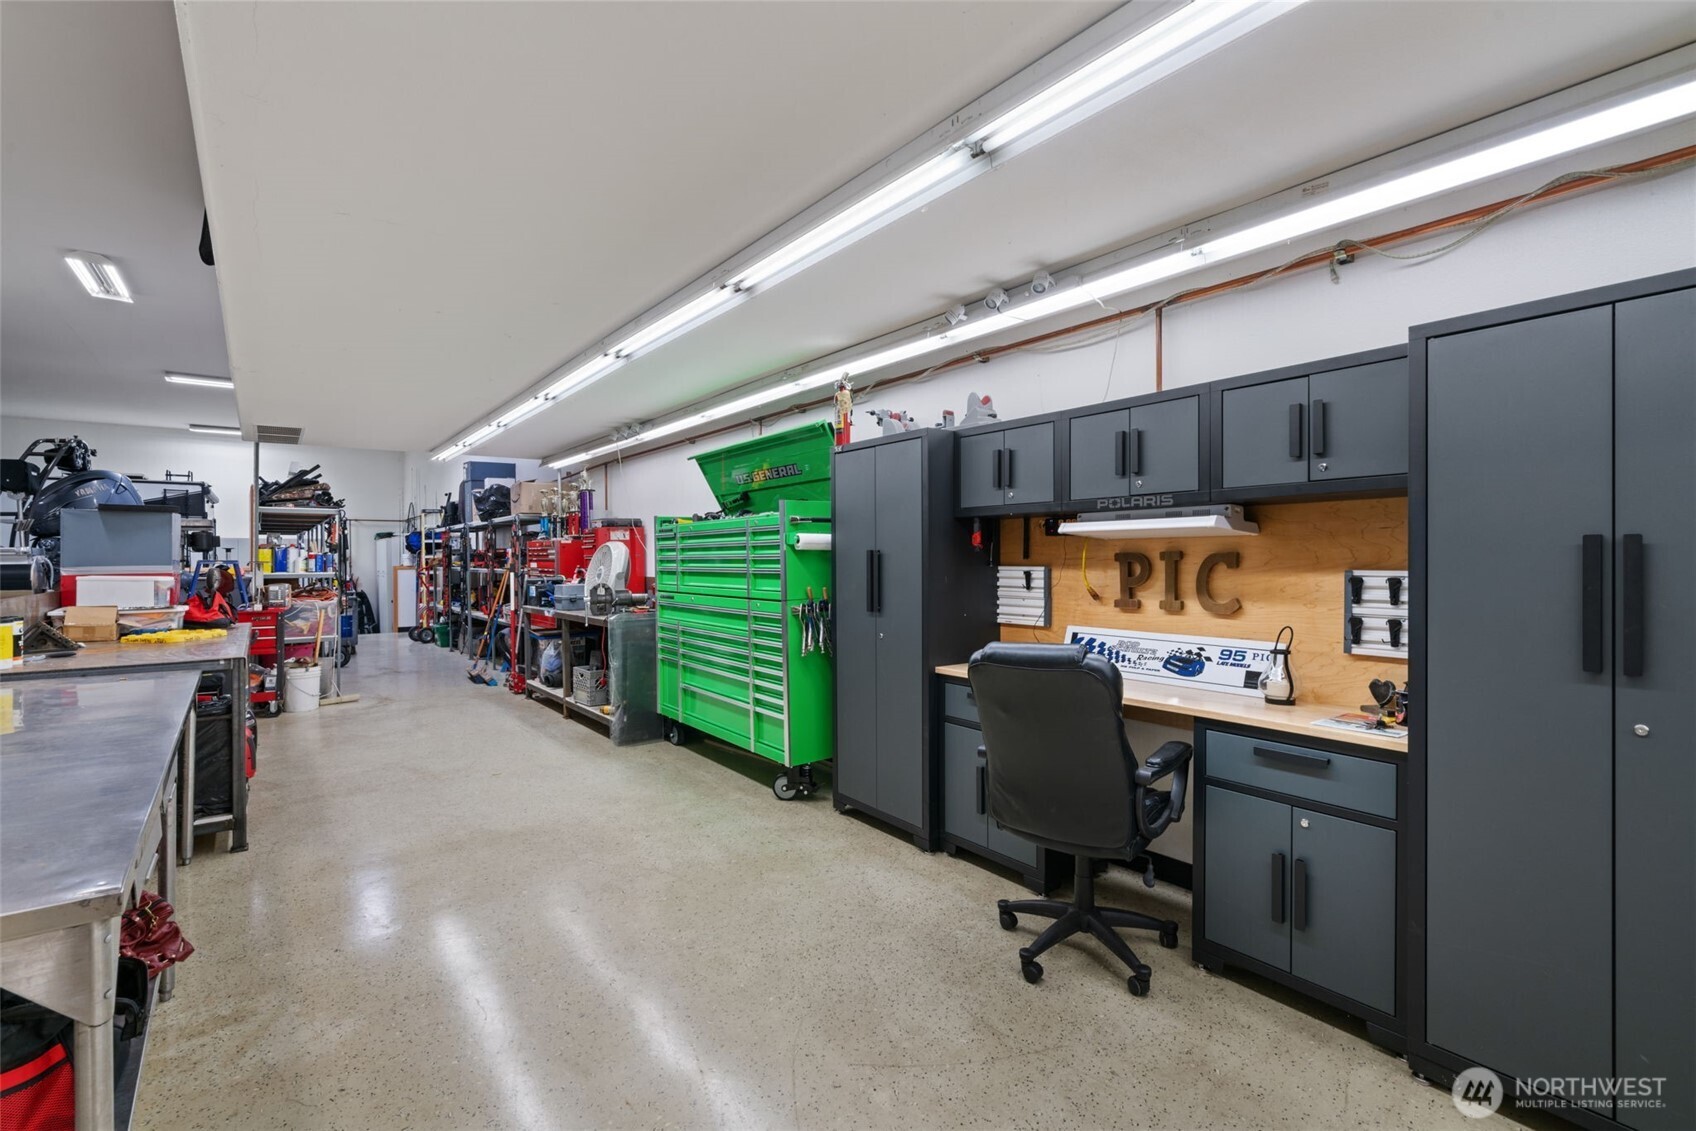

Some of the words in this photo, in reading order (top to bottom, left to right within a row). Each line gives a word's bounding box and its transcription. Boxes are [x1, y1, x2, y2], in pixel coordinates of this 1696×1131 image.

[753, 463, 802, 482] GENERAL
[1097, 494, 1174, 509] POLARIS
[1114, 550, 1242, 615] PIC
[1137, 654, 1165, 662] Racing
[1218, 649, 1248, 663] 95
